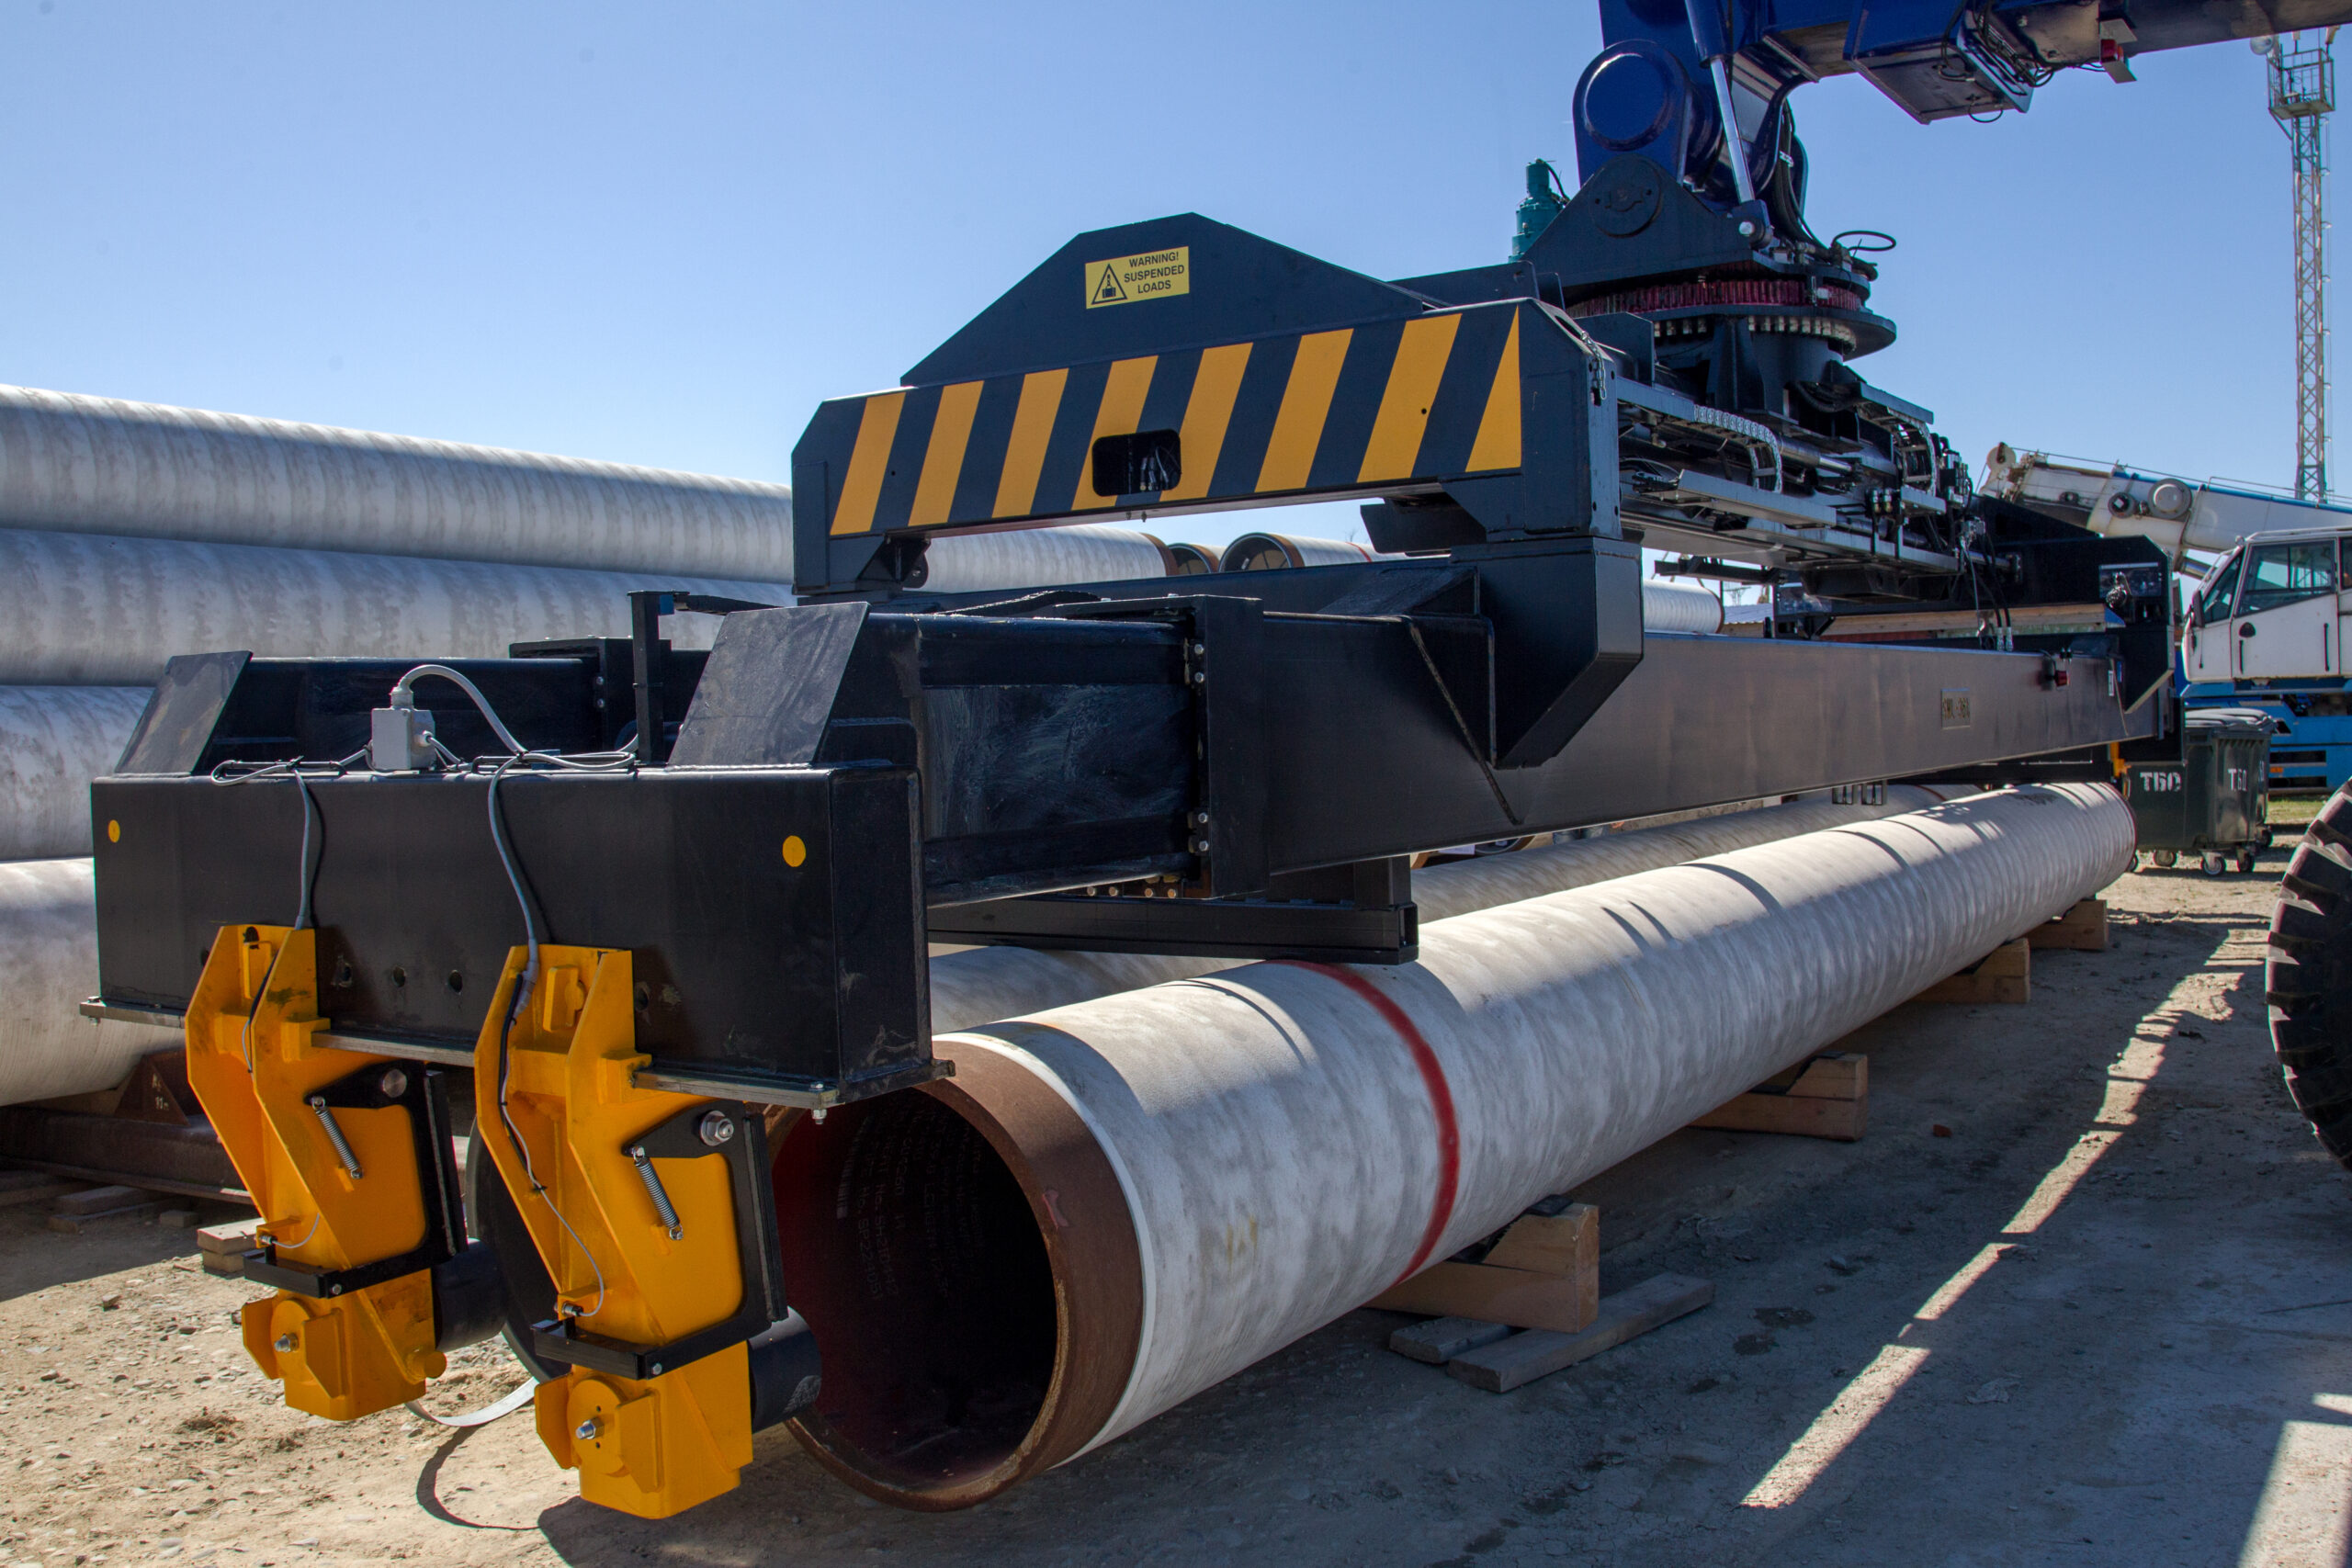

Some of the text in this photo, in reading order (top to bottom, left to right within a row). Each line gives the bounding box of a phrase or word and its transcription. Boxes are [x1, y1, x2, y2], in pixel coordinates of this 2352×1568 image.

[1129, 252, 1179, 267] WARNING!
[1124, 265, 1184, 283] SUSPENDED
[1137, 280, 1171, 294] LOADS
